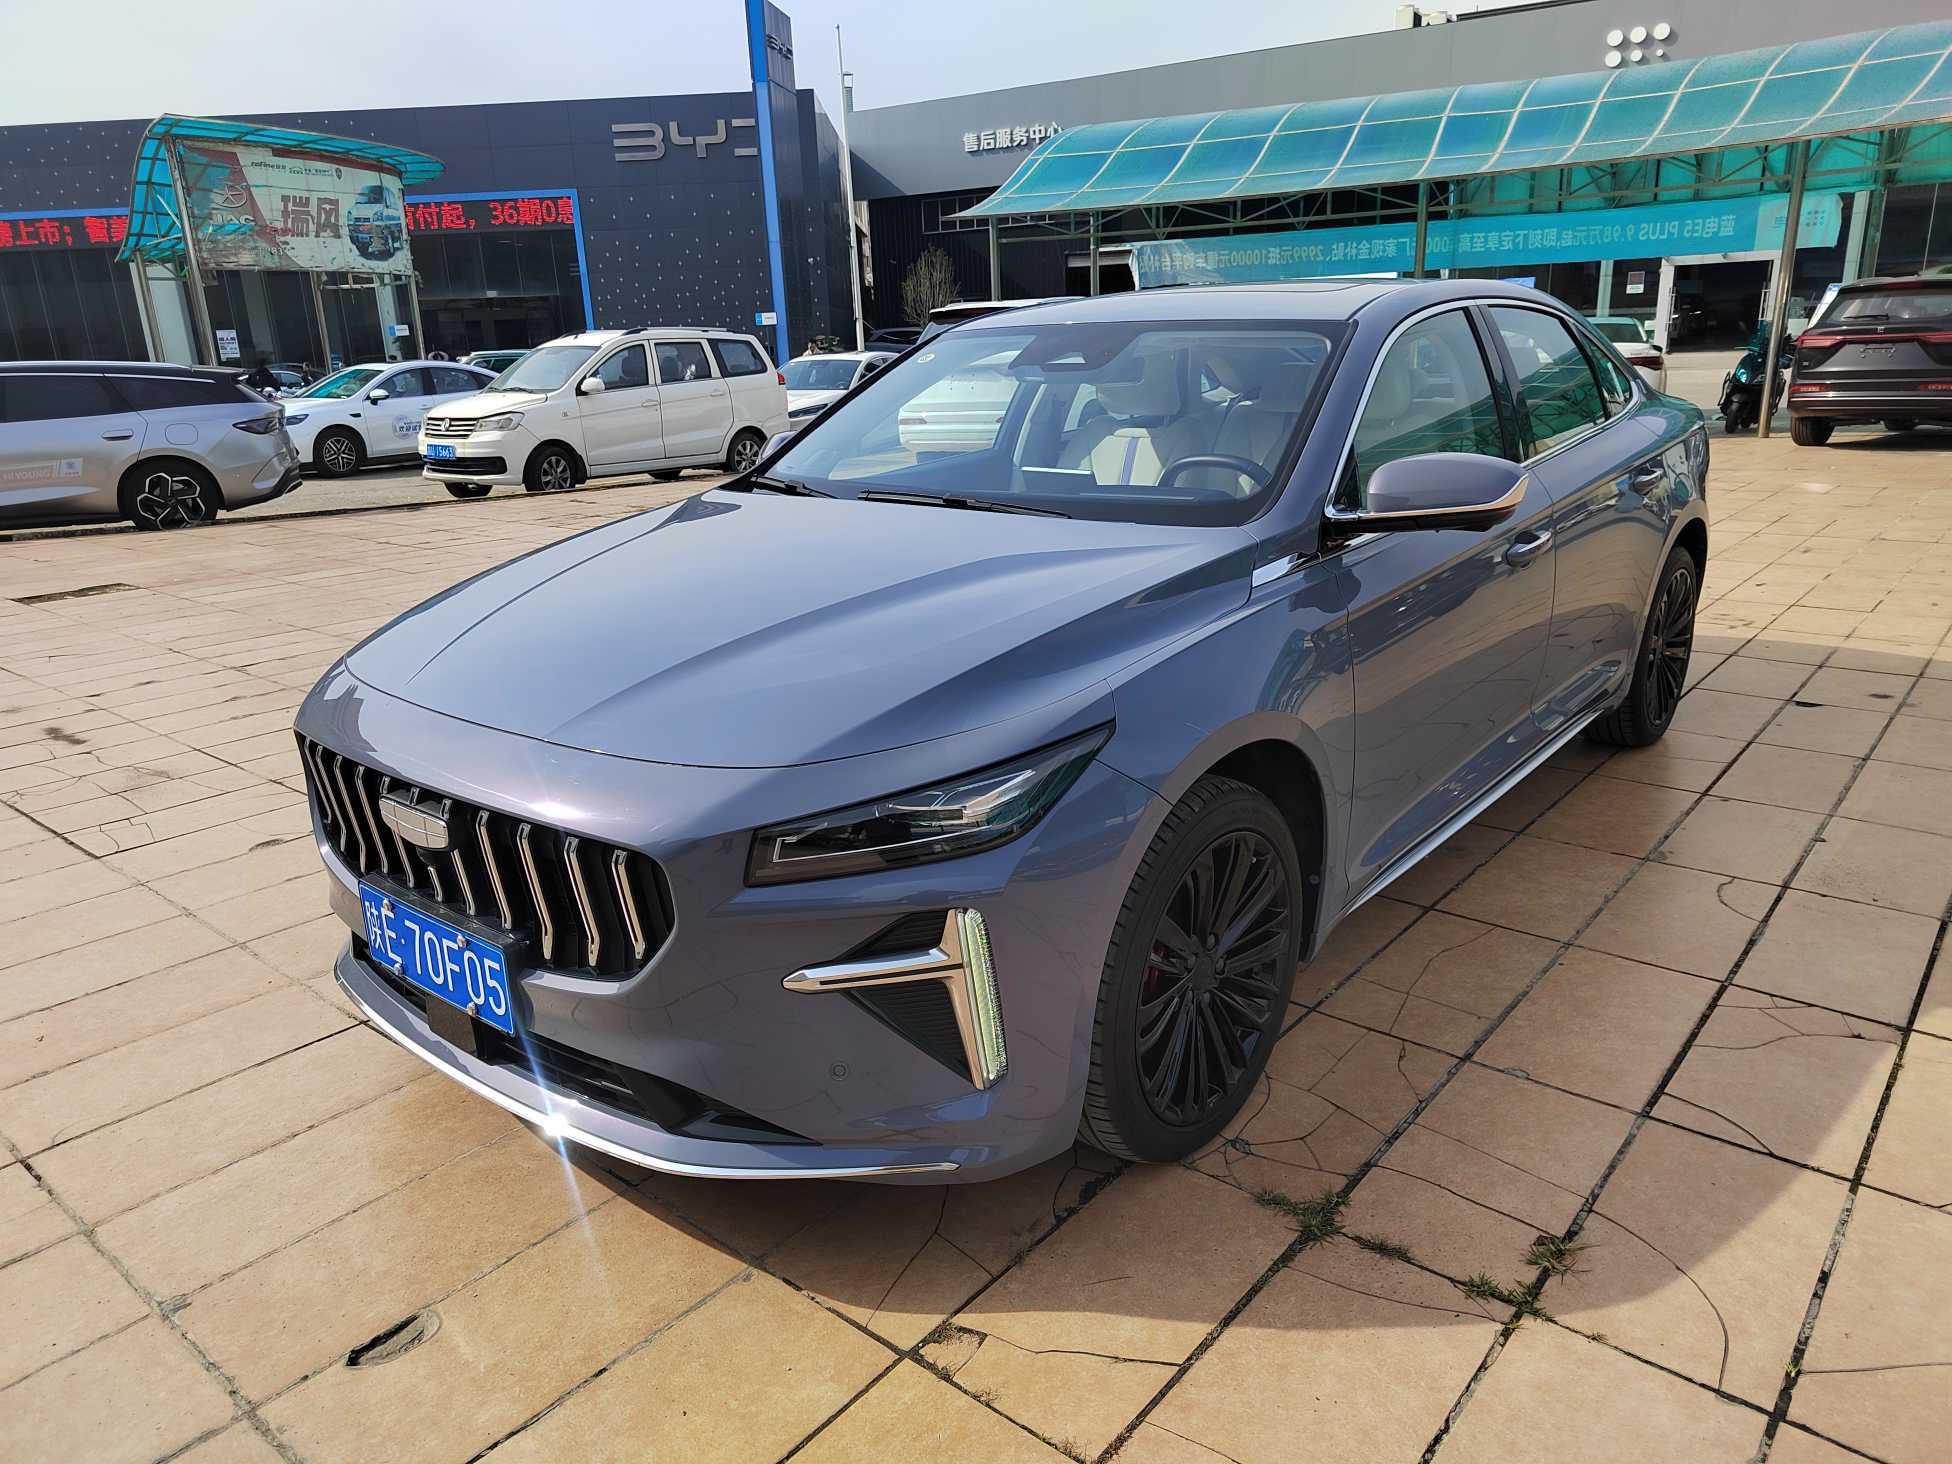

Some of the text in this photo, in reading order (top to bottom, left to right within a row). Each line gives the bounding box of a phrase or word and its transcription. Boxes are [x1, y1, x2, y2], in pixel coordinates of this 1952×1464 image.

[963, 121, 1063, 152] 售后服务中心
[280, 194, 342, 239] 瑞风
